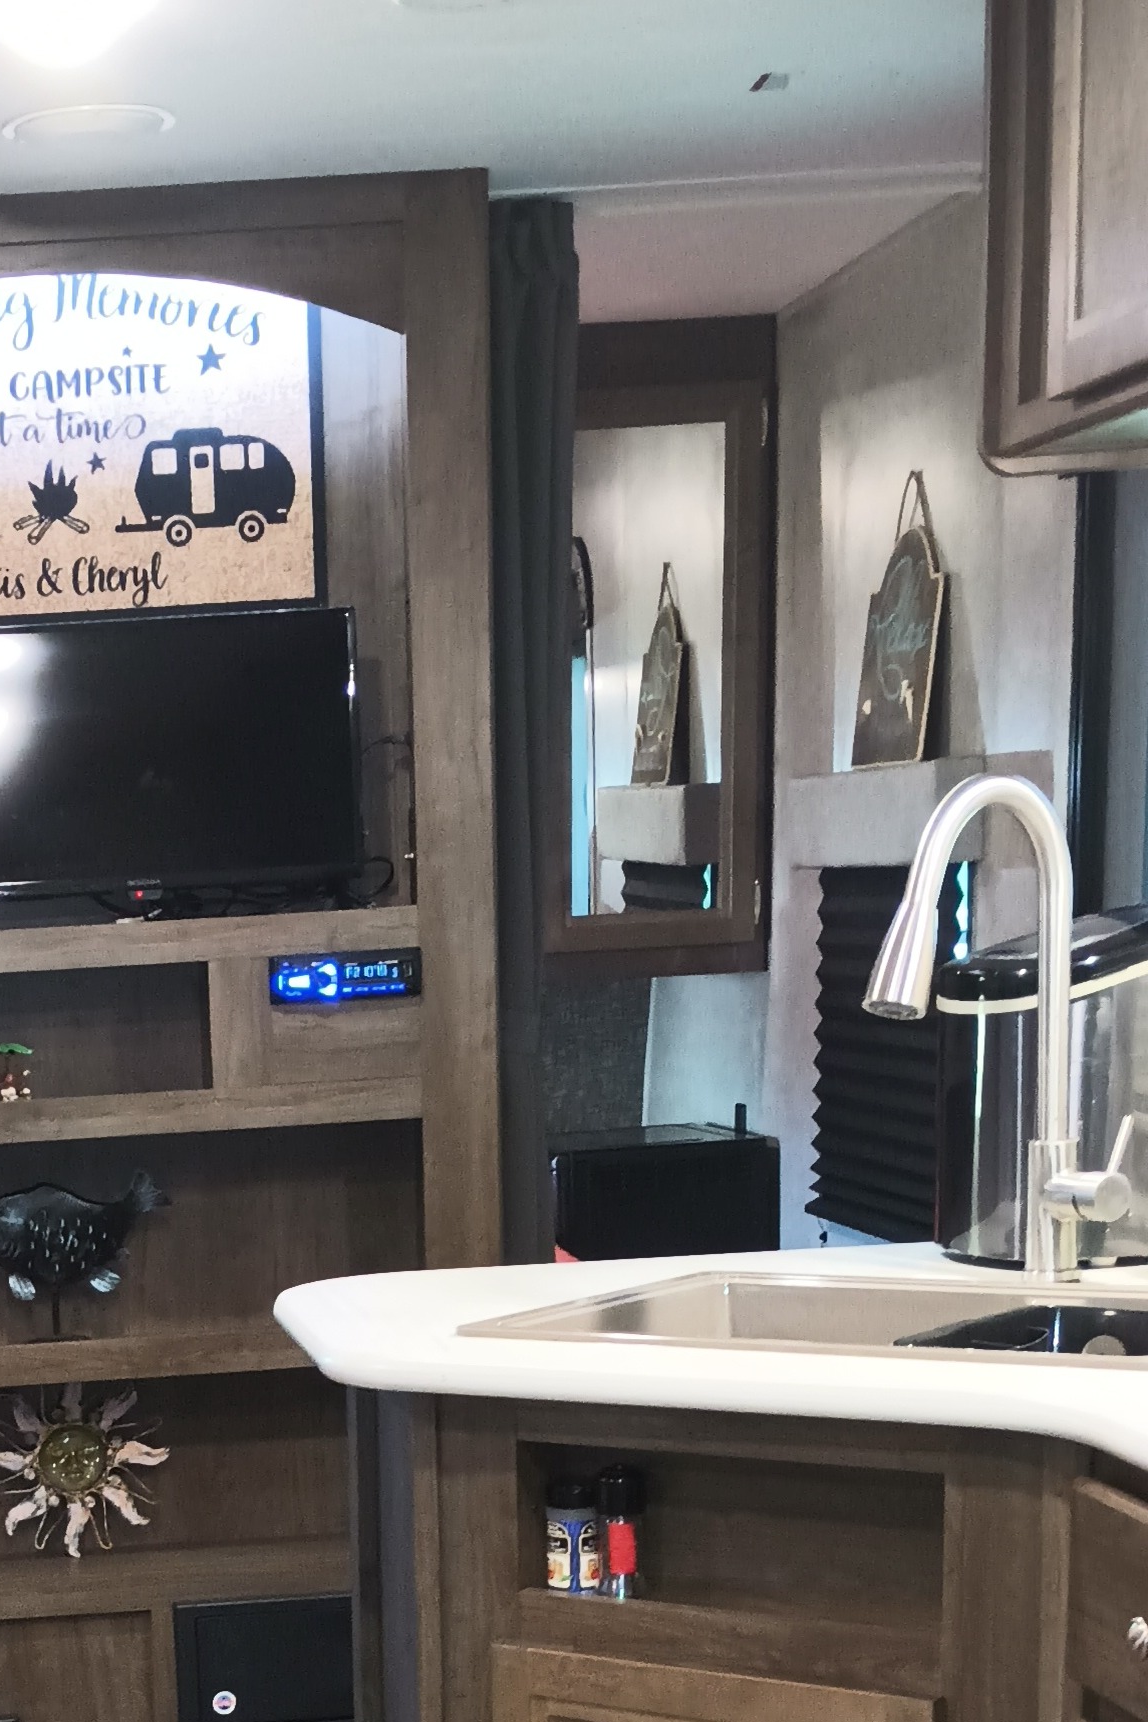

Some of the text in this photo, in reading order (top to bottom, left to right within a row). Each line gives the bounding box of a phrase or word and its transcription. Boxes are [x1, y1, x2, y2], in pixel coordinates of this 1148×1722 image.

[54, 272, 266, 346] Memories
[9, 363, 171, 404] CAMPSITE
[22, 423, 45, 444] a
[36, 407, 147, 444] time
[36, 557, 63, 597] &
[72, 551, 169, 607] Cheryl
